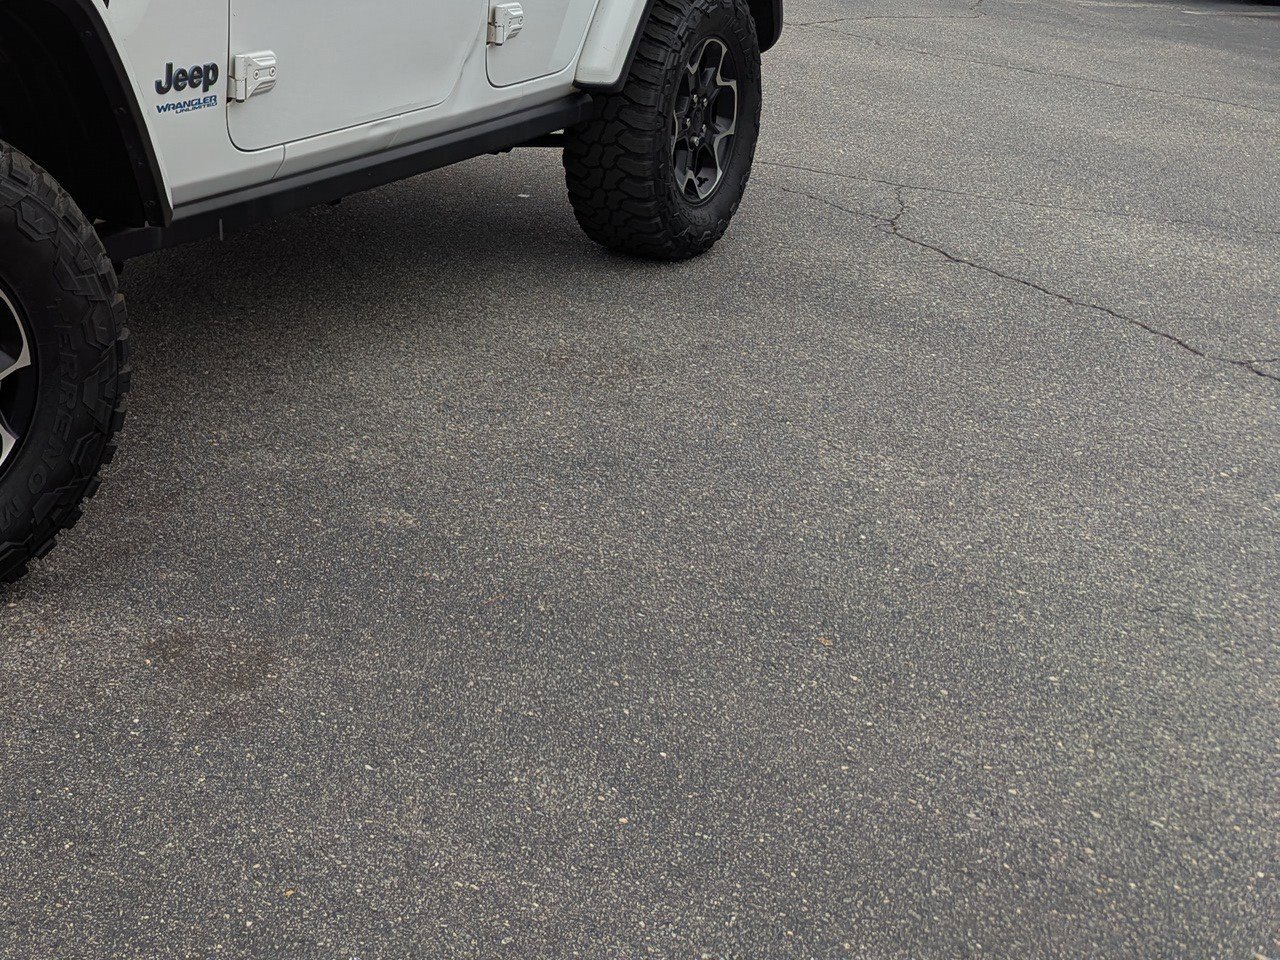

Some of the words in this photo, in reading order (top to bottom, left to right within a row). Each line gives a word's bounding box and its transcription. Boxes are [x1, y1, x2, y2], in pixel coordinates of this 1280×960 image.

[155, 62, 219, 94] Jeep
[156, 95, 217, 114] WRANGLER
[175, 102, 218, 114] UNLIMITED
